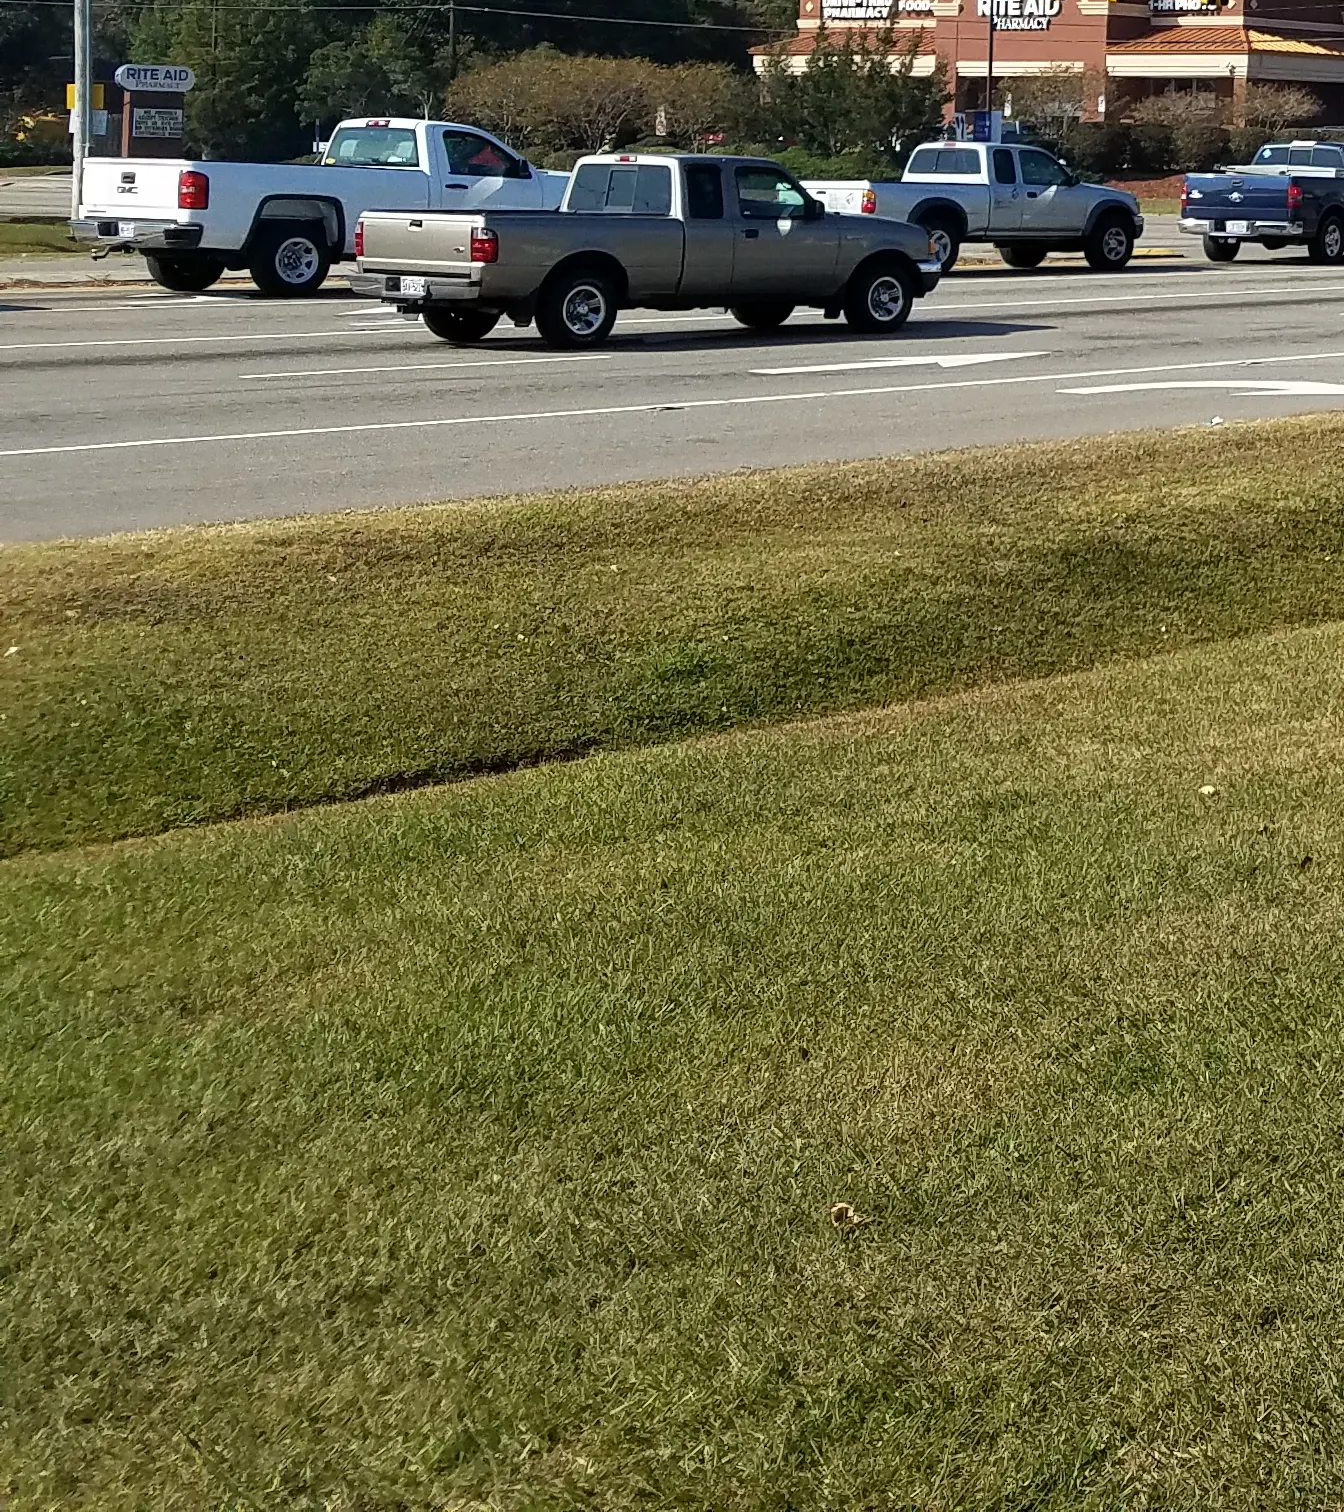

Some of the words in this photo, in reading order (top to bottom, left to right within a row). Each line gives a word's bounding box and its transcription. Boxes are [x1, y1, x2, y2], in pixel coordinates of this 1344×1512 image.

[1148, 0, 1173, 10] 1-HR
[1175, 0, 1217, 10] PHO
[823, 7, 889, 18] PHARMACY
[127, 68, 159, 80] RITE
[163, 70, 188, 81] AID
